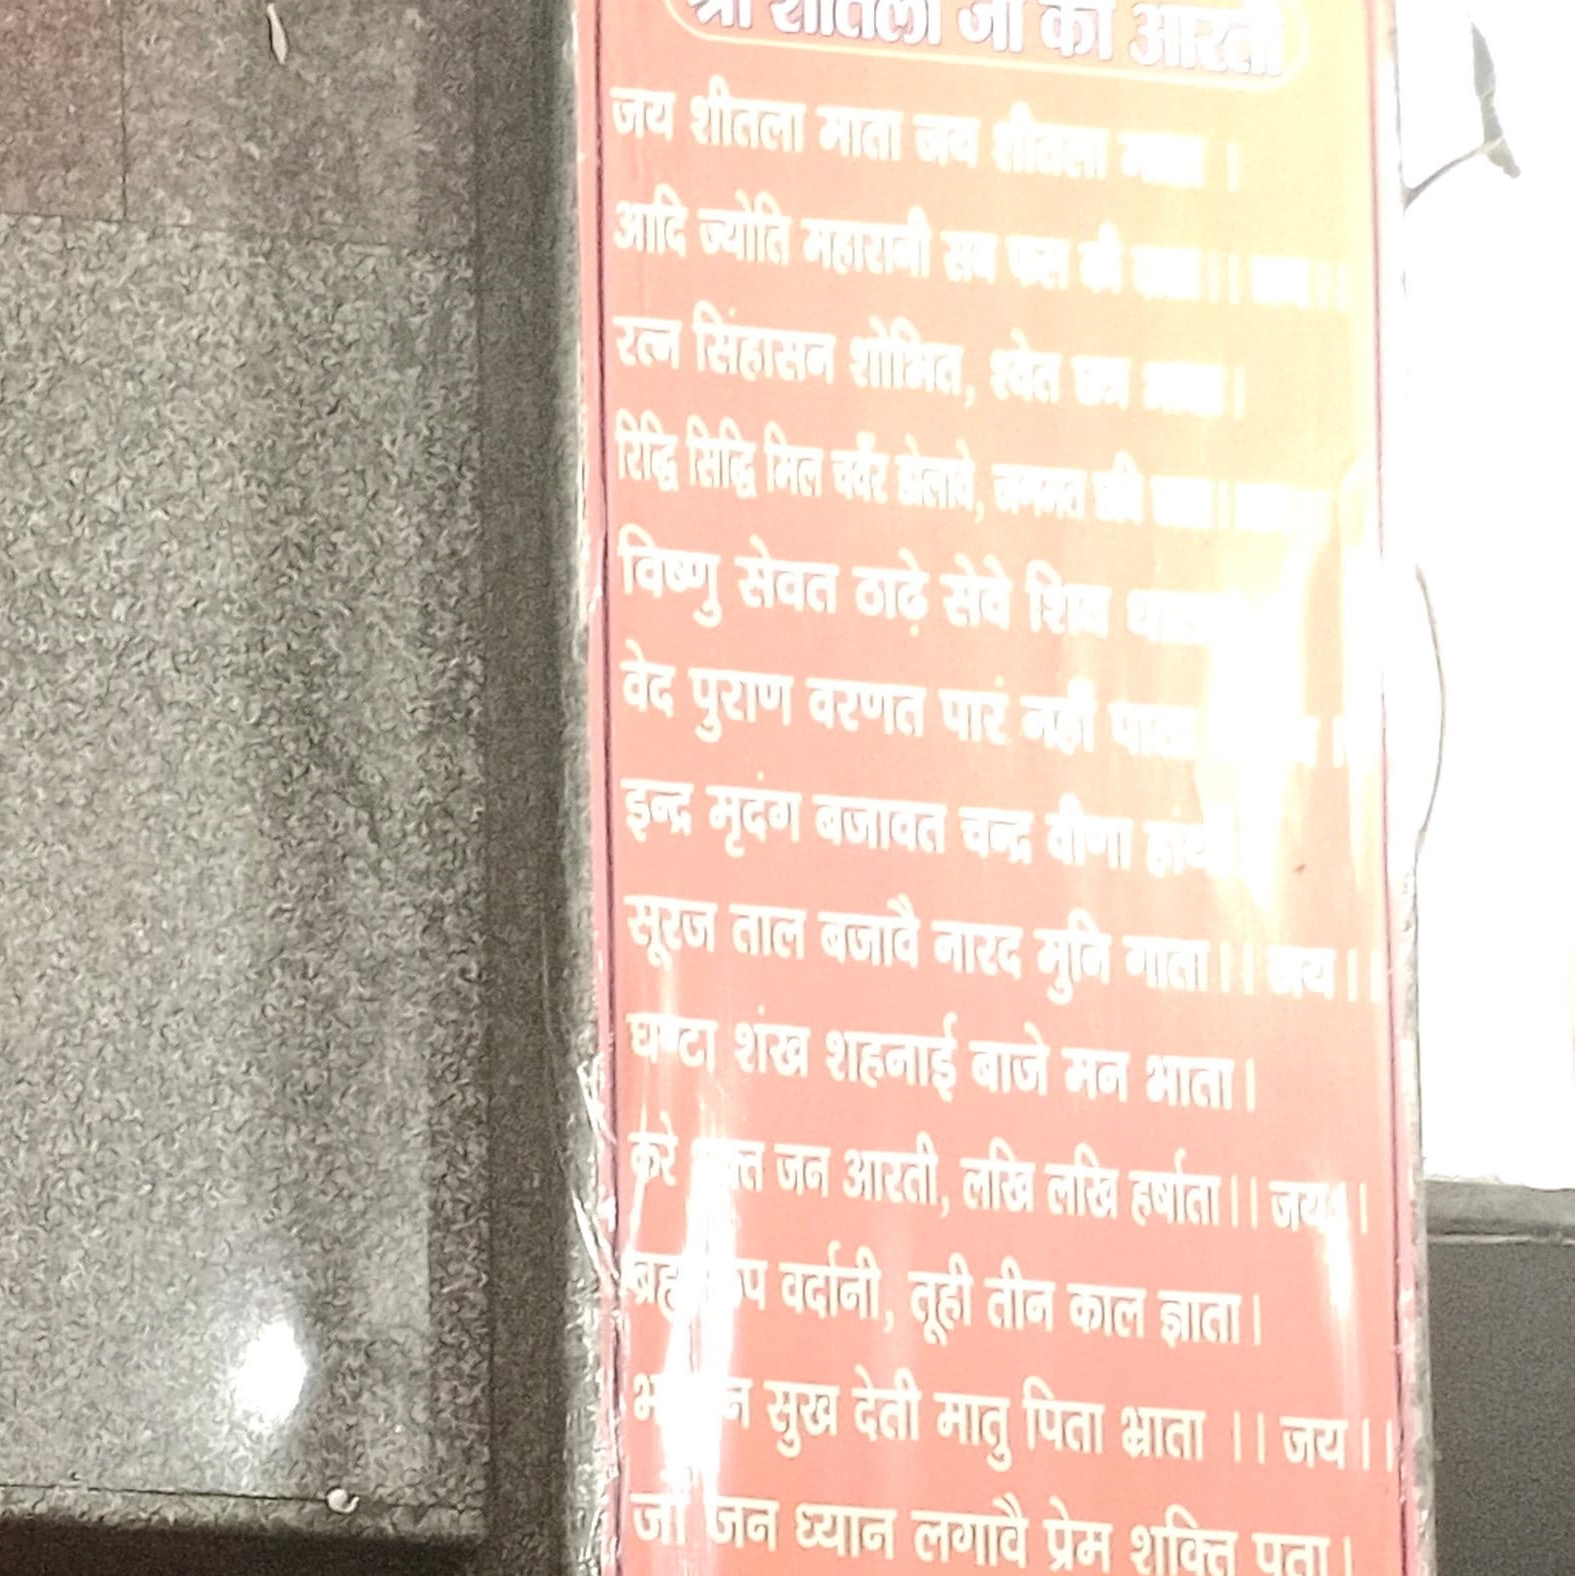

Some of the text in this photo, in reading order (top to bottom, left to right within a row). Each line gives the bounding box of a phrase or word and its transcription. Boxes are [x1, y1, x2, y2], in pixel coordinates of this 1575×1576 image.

[608, 73, 806, 153] जय शीतला
[612, 182, 792, 265] आदि ज्योति
[616, 522, 930, 636] विष्णु सेवत ठाढ़े
[618, 637, 795, 744] वेद पुराण
[622, 893, 1024, 980] सूरज ताल बजावै नारद
[733, 1003, 1050, 1103] शंख शहनाई बाजे
[777, 1238, 1147, 1346] वर्दानी, तूही तीन काल
[762, 1379, 840, 1458] सुख
[850, 1362, 922, 1442] देती
[931, 1391, 1012, 1473] मातु
[1021, 1374, 1106, 1455] पिता
[794, 1502, 898, 1560] ध्यान
[910, 1491, 1029, 1569] लगावै
[1041, 1494, 1114, 1574] प्रेम
